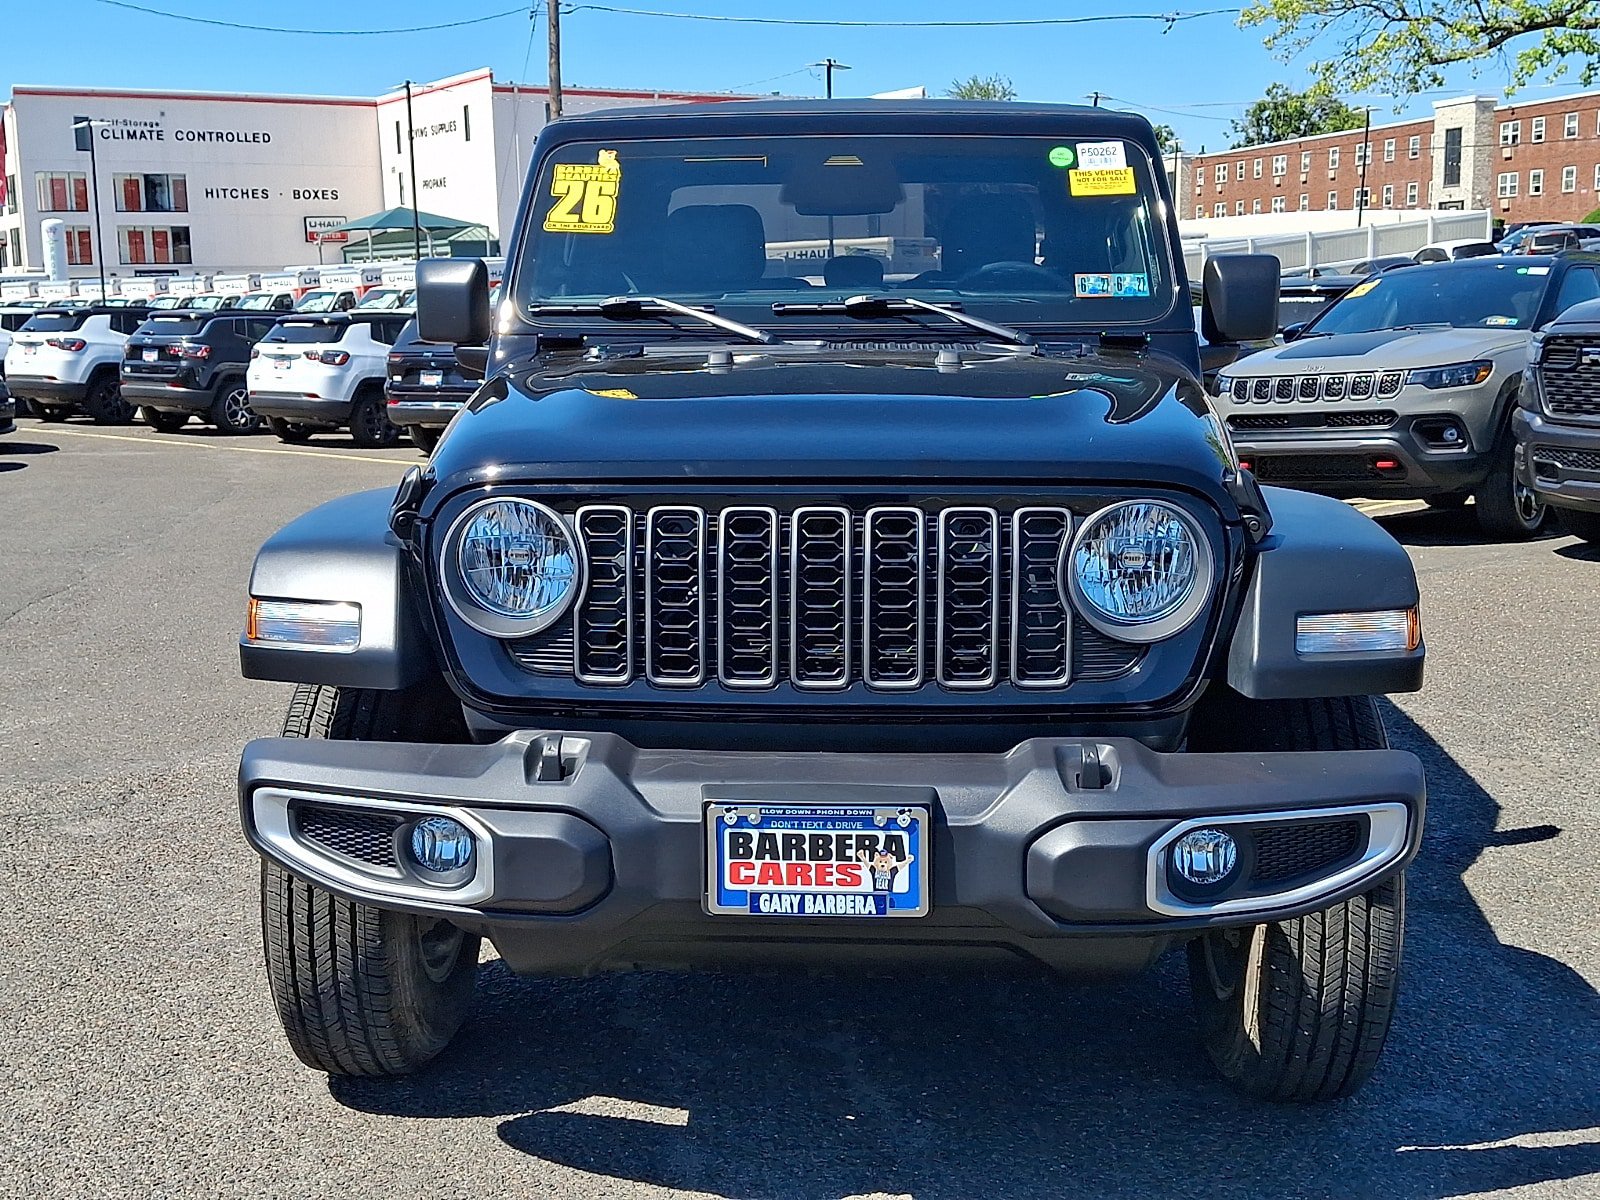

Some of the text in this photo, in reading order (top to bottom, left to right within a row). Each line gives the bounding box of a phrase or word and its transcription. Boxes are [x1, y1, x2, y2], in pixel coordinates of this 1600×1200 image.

[100, 128, 271, 144] CLIMATE CONTROLLED
[431, 120, 457, 136] SUPPLIES
[1080, 147, 1117, 156] P50262
[205, 188, 339, 200] HITCHES BOXES
[548, 180, 617, 224] 26
[1080, 277, 1087, 293] 6
[1116, 276, 1123, 292] 6
[771, 819, 863, 830] DON'T TEXT & DRIVE
[729, 831, 906, 863] BARBERA
[729, 862, 862, 888] CARES
[759, 893, 877, 915] GARY BARBERA
